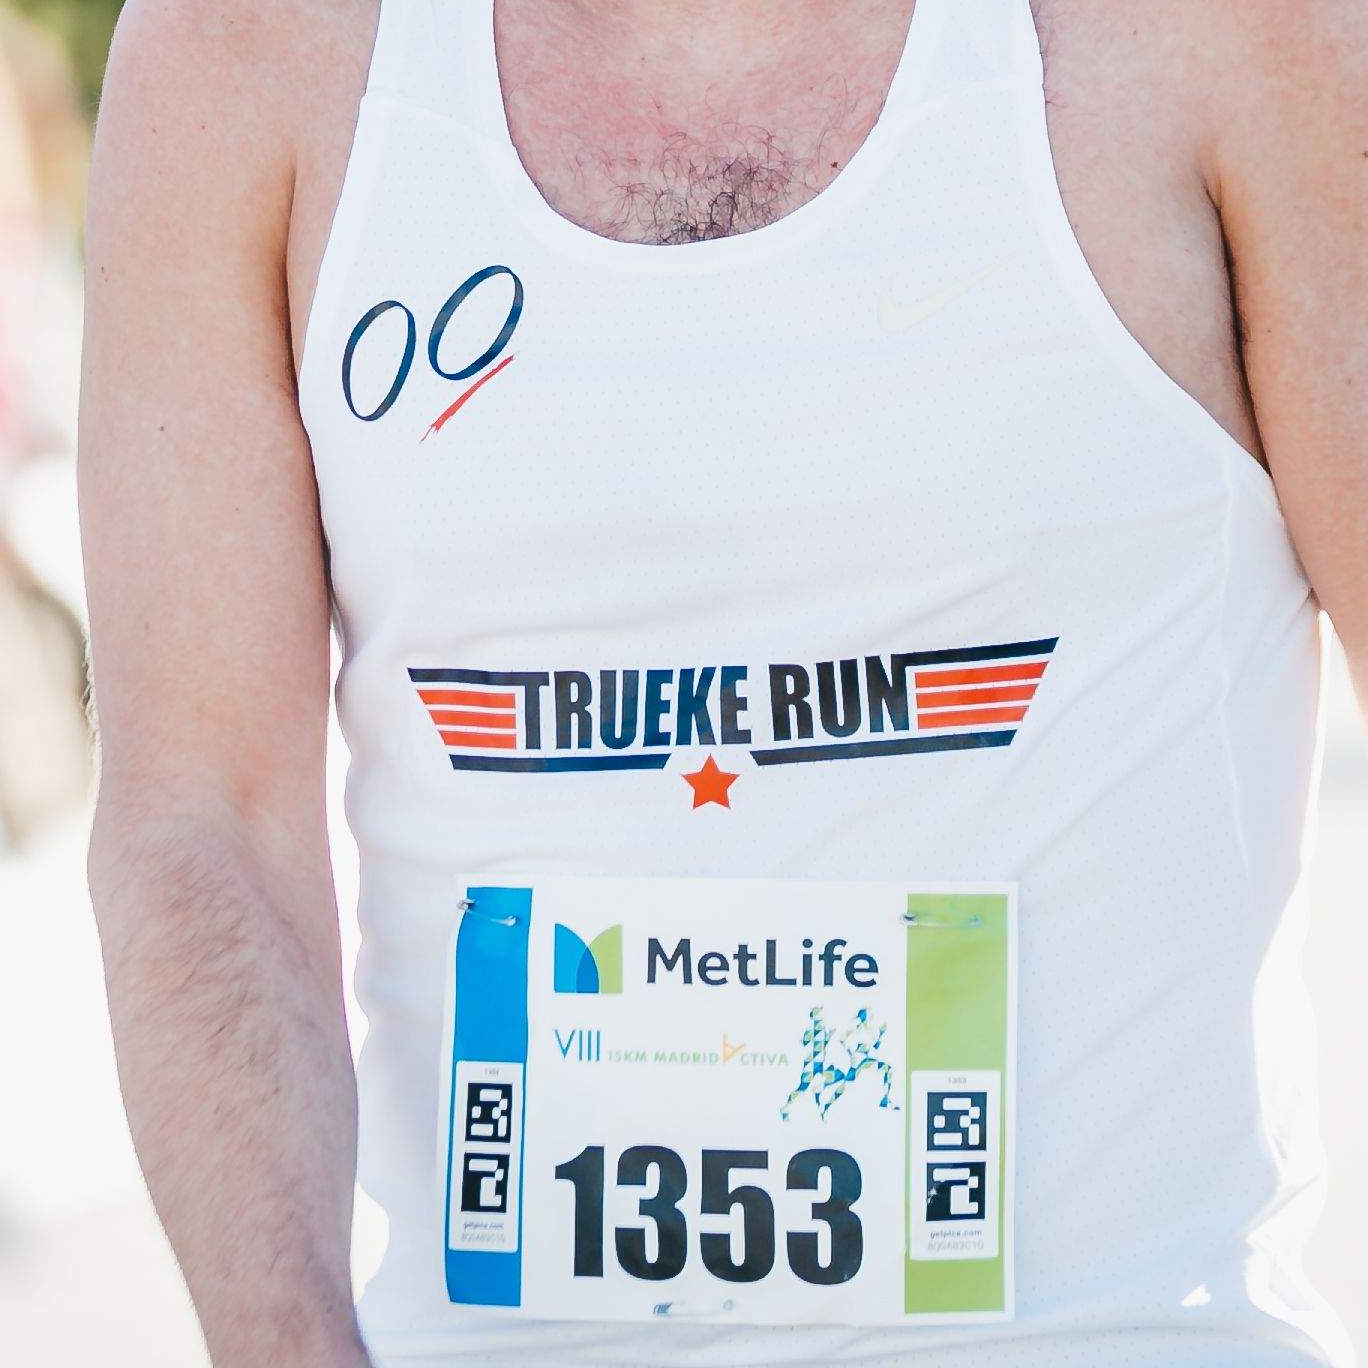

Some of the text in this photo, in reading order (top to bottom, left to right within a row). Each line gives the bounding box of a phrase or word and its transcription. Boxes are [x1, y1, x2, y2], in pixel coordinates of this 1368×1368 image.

[524, 654, 910, 751] TRUEKE RUN
[646, 937, 879, 988] MetLife
[554, 1029, 601, 1062] VIII
[654, 1051, 719, 1065] MADRID
[554, 1145, 864, 1286] 1353
